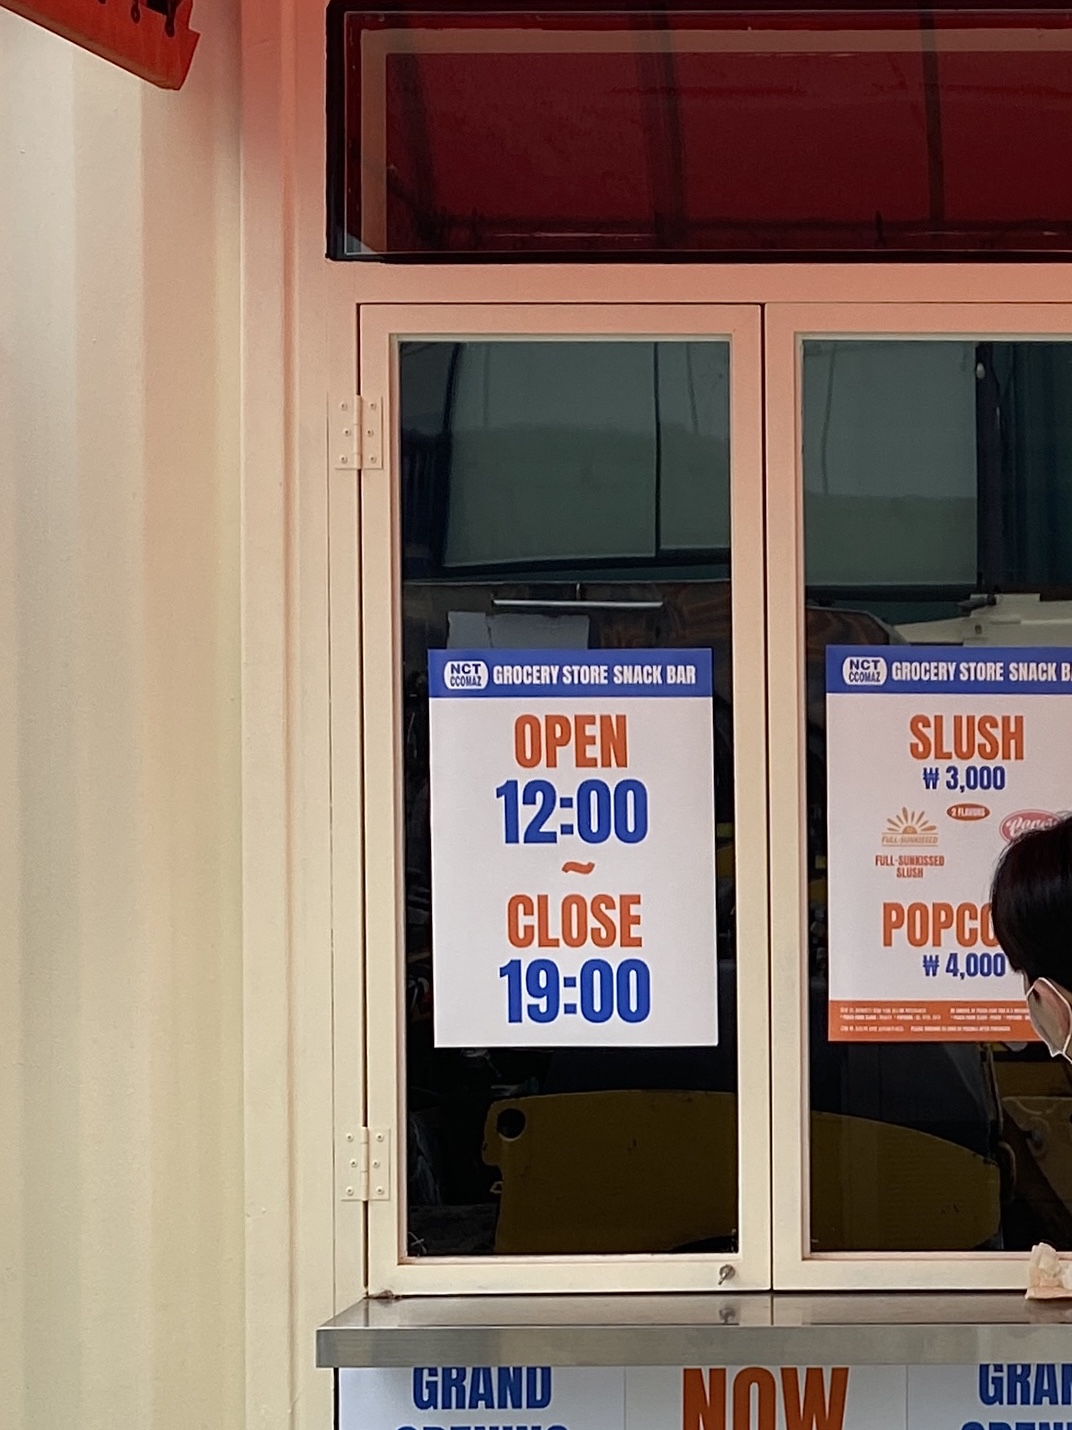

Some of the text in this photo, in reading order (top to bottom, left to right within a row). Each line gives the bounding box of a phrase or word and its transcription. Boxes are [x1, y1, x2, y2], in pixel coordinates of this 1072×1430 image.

[450, 663, 481, 674] NCT
[493, 664, 696, 685] GROCERY STORE SNACK BAR
[850, 659, 880, 671] NCT
[892, 661, 956, 682] GROCERY
[959, 661, 1004, 682] STORE
[1009, 661, 1057, 682] SNACK
[450, 674, 482, 687] CCOMAZ
[514, 714, 628, 768] OPEN
[909, 714, 1024, 761] SLUSH
[945, 766, 1006, 793] 3,000
[496, 779, 648, 844] 12:00
[896, 867, 924, 878] SLUSH
[507, 893, 643, 948] CLOSE
[883, 902, 1000, 947] POPCO
[945, 952, 1006, 980] 4,000
[500, 959, 651, 1023] 19:00
[412, 1366, 552, 1410] GRAND
